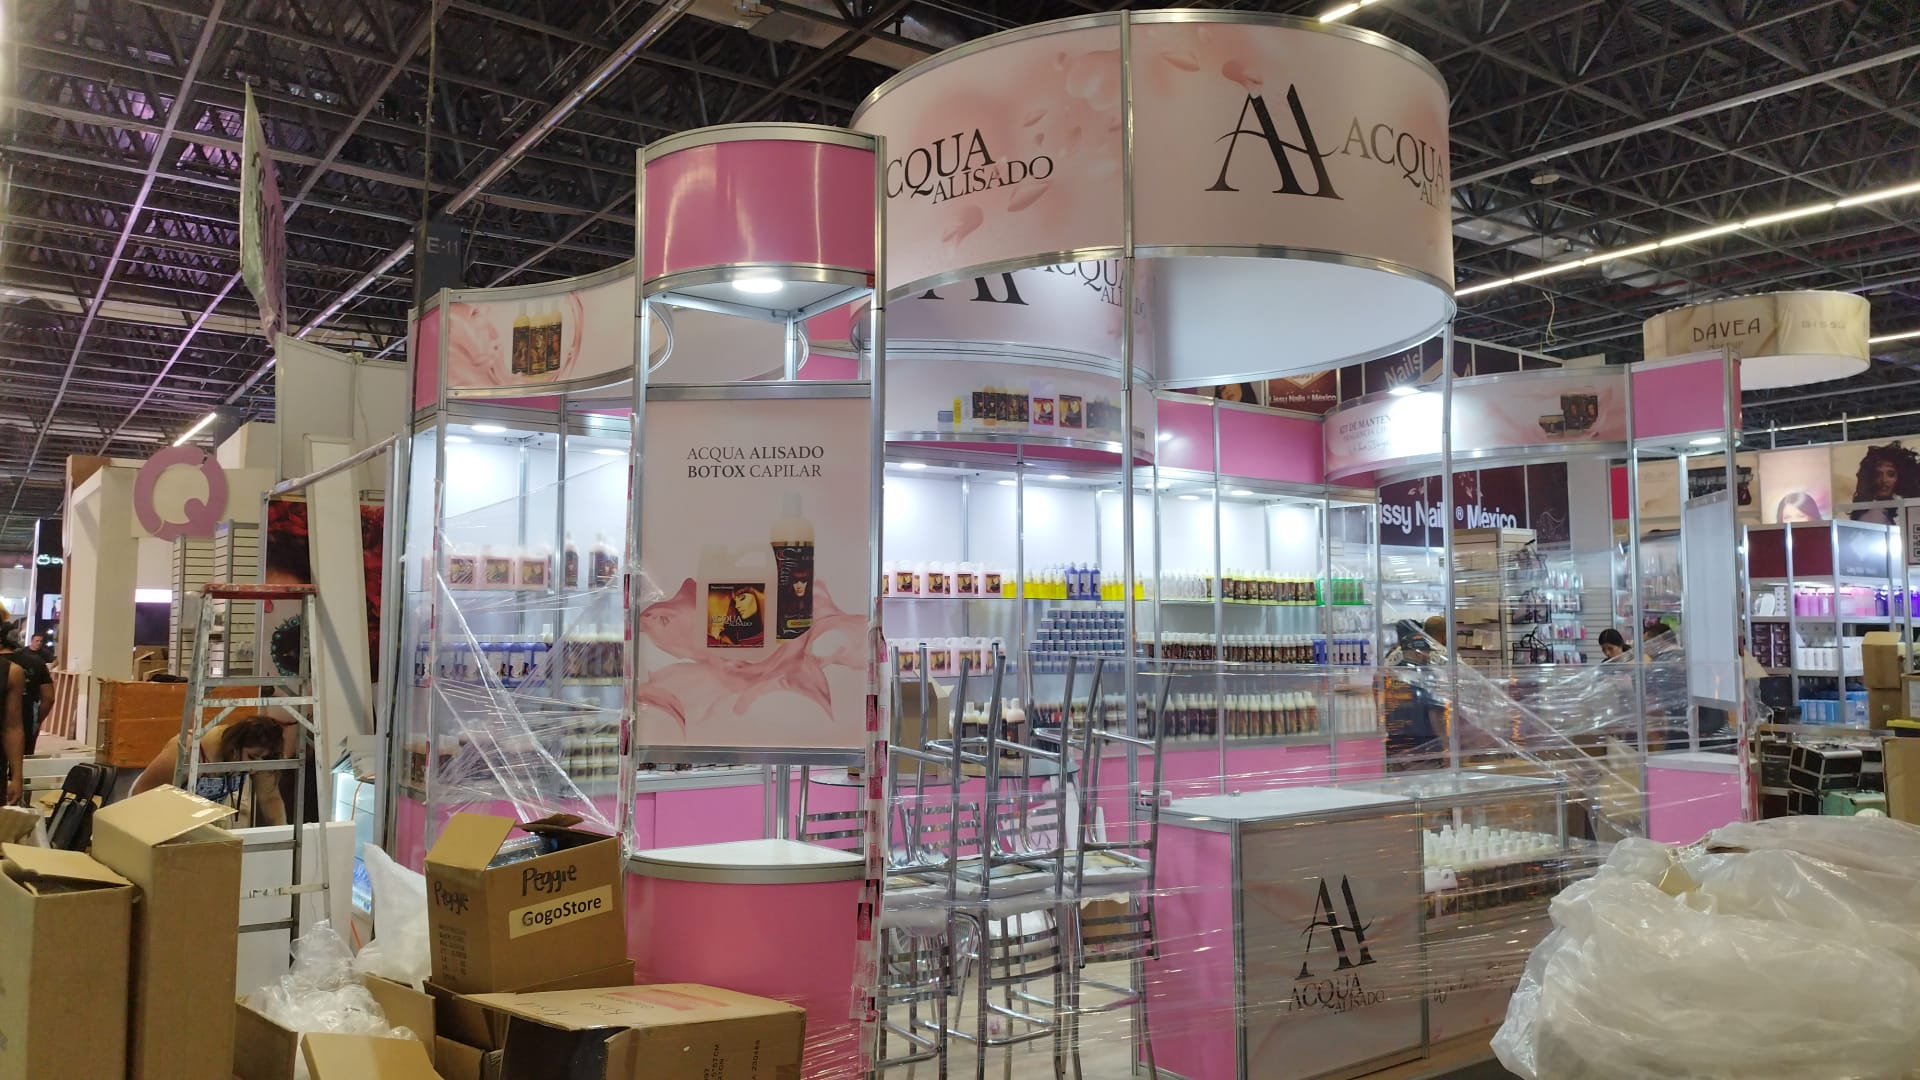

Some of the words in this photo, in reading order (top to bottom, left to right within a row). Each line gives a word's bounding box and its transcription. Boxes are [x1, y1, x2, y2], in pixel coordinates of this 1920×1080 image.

[1341, 115, 1446, 194] ACQUA
[932, 156, 1054, 204] ALISADO
[426, 236, 458, 256] E-11
[1693, 317, 1761, 343] DAVEA
[687, 446, 745, 462] ACQUA
[750, 446, 824, 459] ALISADO
[688, 465, 745, 478] BOTOX
[750, 464, 822, 478] CAPILAR
[1467, 504, 1518, 529] México
[522, 865, 578, 896] Peggie
[522, 897, 602, 927] GogoStore
[1288, 972, 1363, 1011] ACQUA
